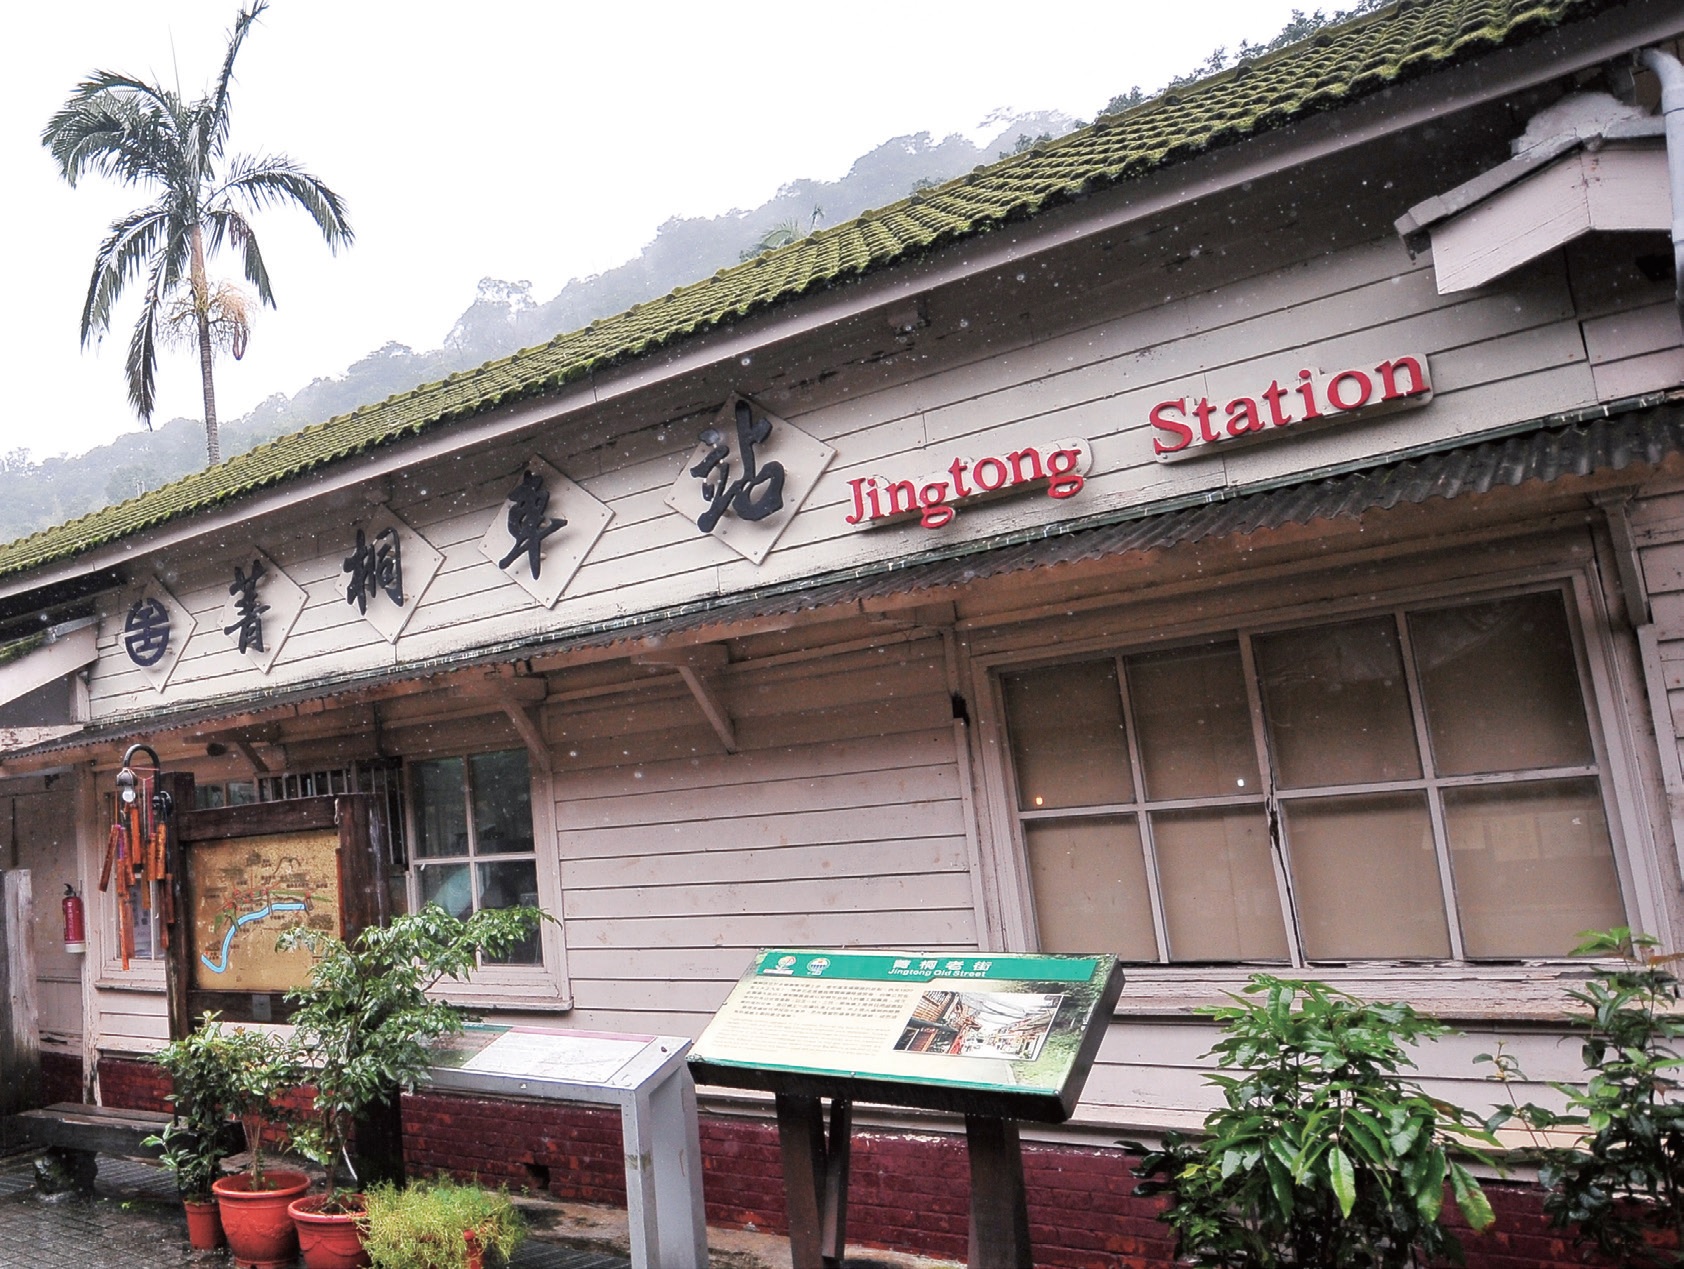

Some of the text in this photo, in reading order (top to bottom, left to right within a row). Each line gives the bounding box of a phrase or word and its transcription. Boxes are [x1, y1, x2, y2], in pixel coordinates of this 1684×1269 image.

[223, 400, 786, 654] 菁桐車站
[846, 355, 1431, 528] Jingtong Station
[888, 969, 987, 978] Jingtong Old Street
